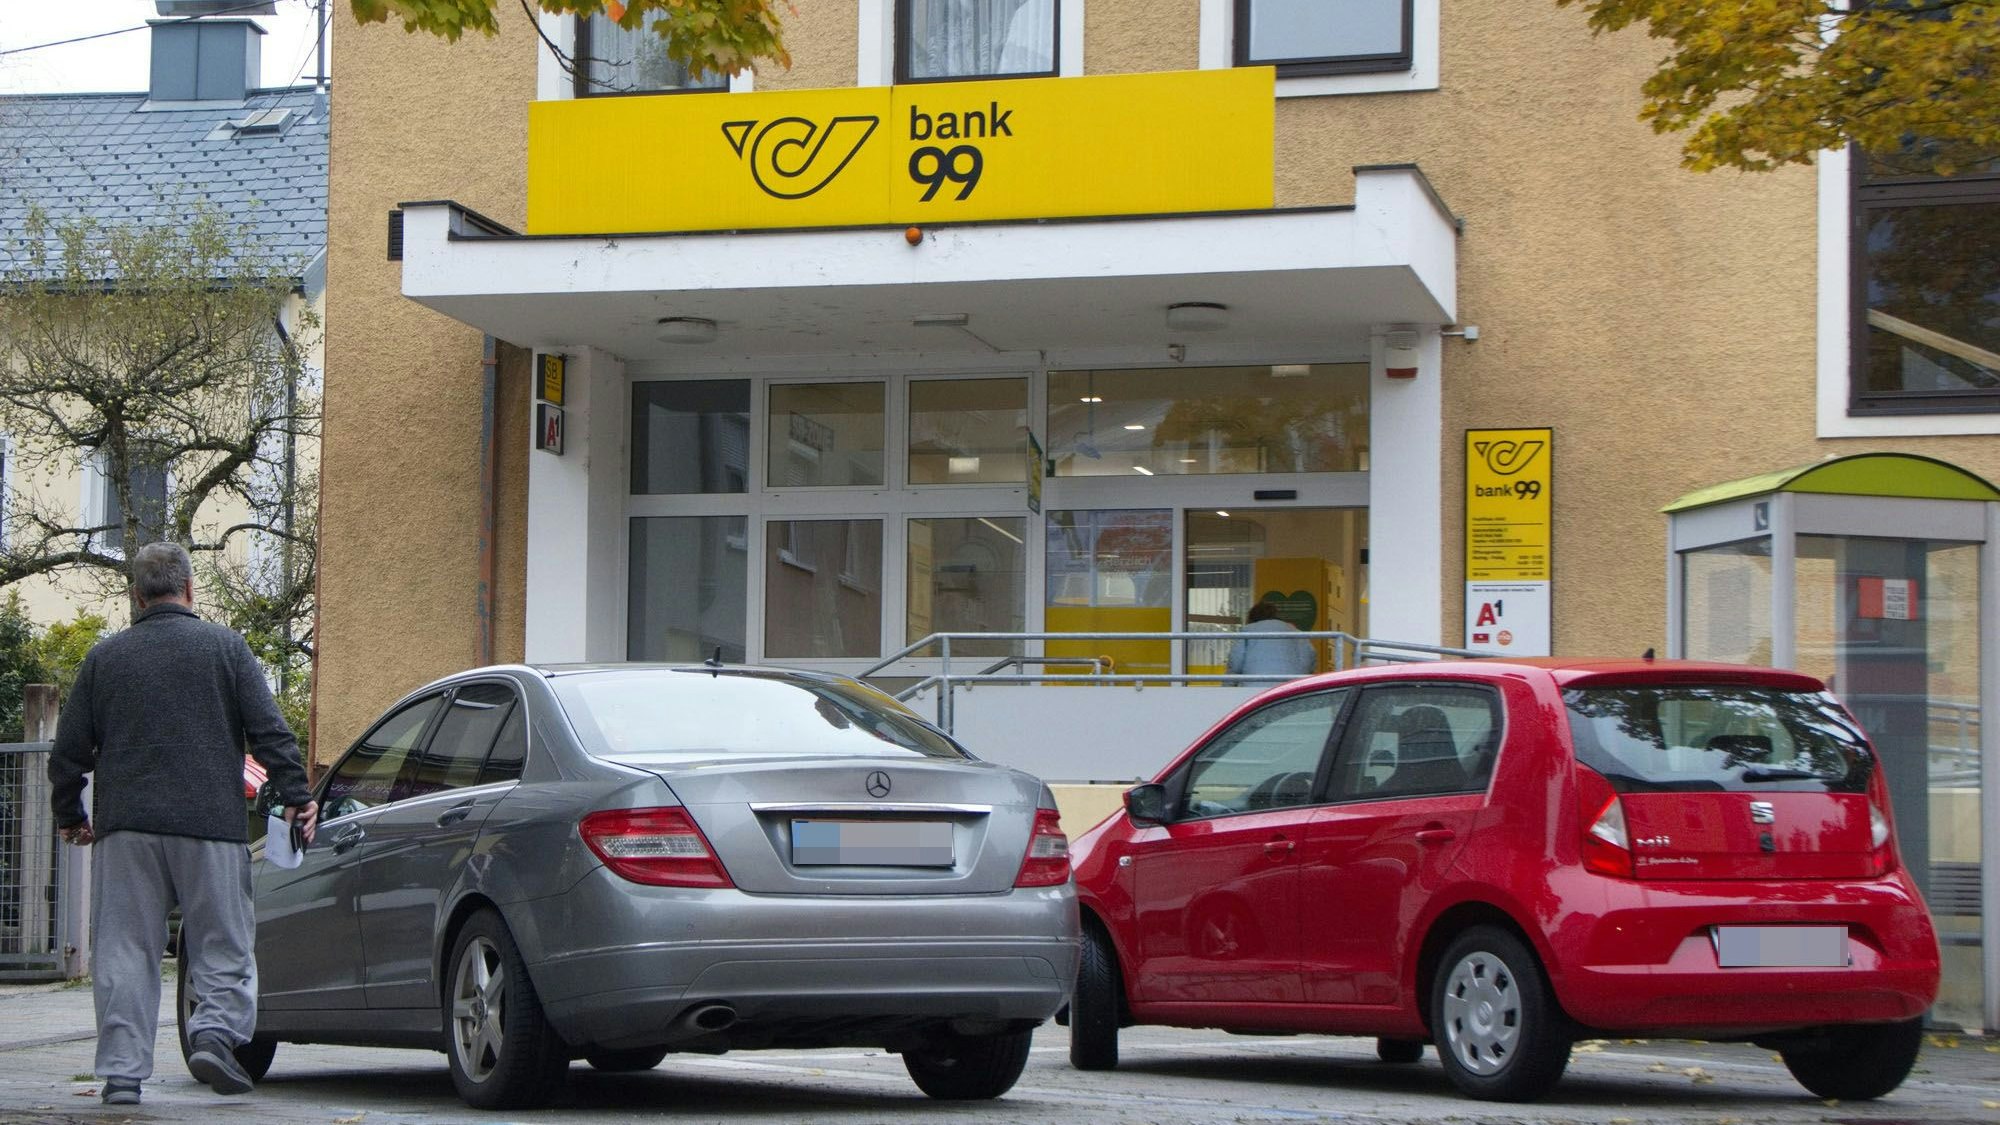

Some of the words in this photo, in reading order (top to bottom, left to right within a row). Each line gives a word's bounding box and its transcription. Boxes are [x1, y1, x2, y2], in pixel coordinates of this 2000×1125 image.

[910, 102, 1014, 141] bank
[908, 145, 983, 202] 99
[546, 360, 558, 379] SB
[546, 415, 560, 446] A1
[1476, 599, 1502, 627] A1
